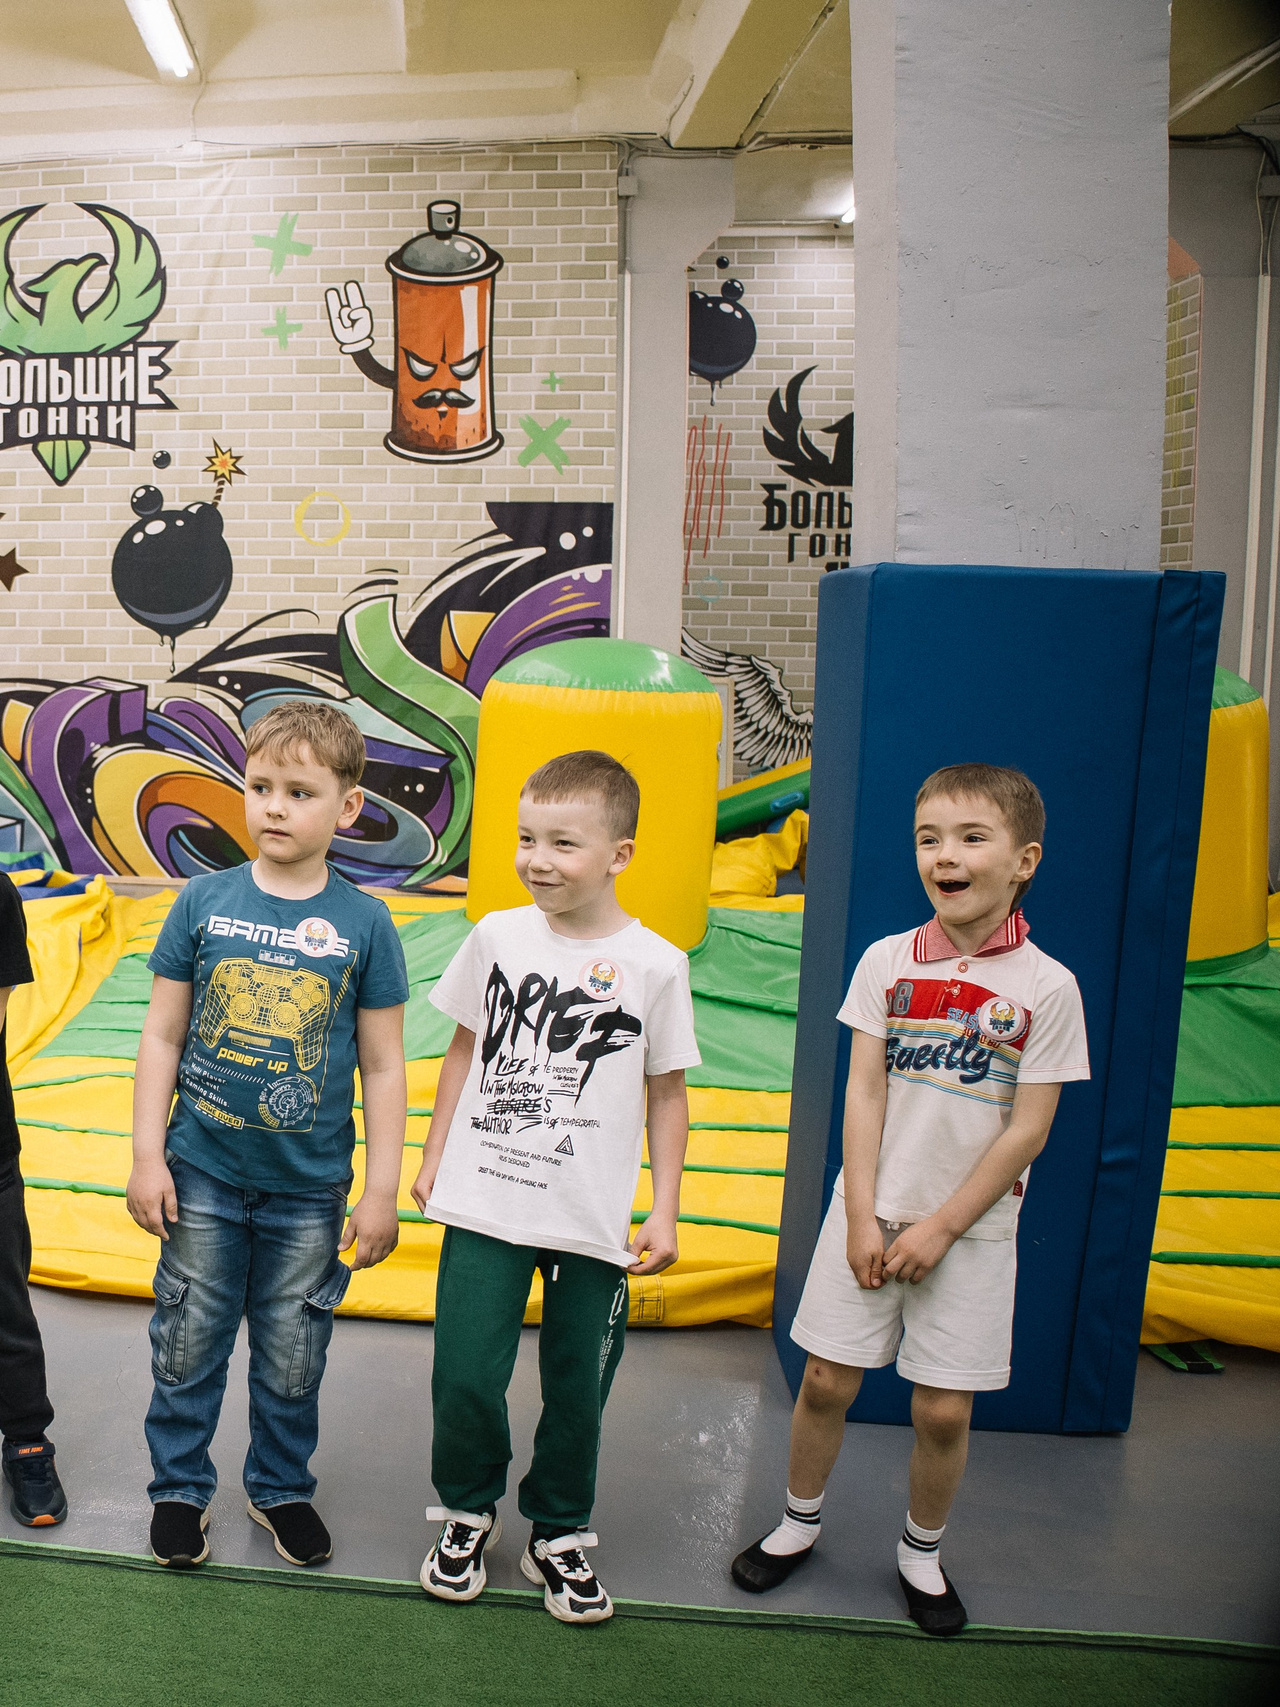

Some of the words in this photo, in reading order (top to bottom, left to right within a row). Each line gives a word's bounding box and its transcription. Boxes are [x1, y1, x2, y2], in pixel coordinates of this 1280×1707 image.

[207, 915, 350, 957] GAMES
[217, 1047, 264, 1067] power
[267, 1060, 288, 1075] up
